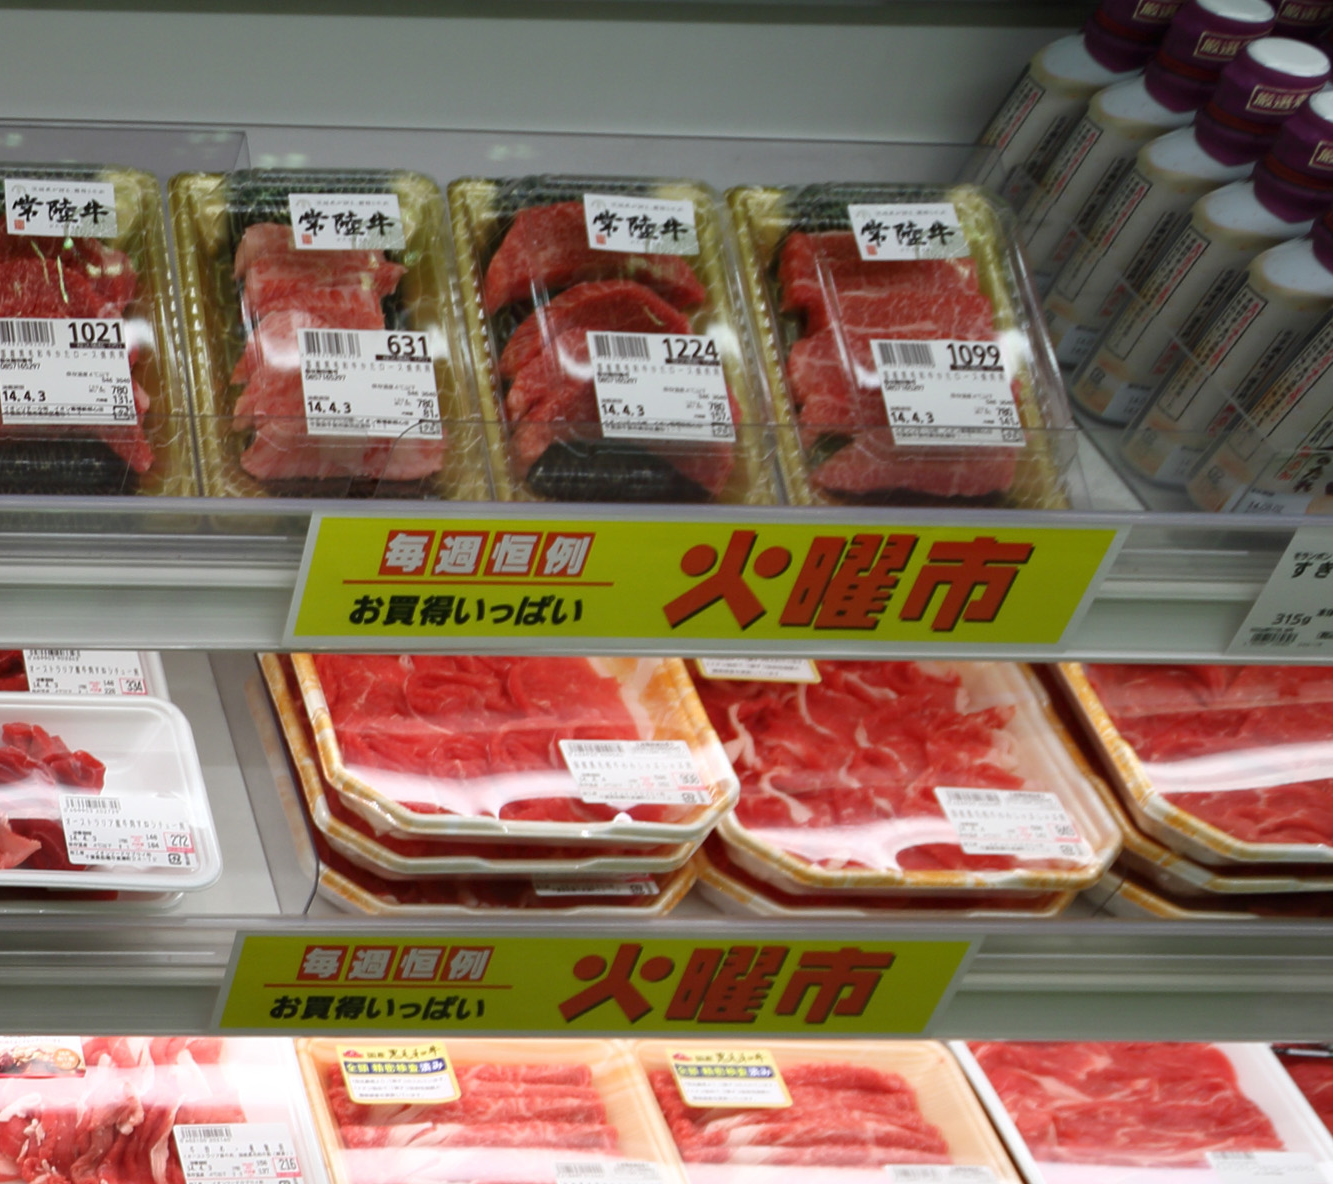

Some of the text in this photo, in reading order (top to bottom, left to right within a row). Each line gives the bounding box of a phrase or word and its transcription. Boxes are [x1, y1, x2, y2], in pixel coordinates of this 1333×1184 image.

[12, 199, 109, 225] 常陸牛
[298, 209, 394, 237] 常陸牛
[593, 211, 688, 241] 常陸牛
[861, 219, 954, 247] 常陸牛
[68, 322, 123, 343] 1021
[387, 335, 429, 356] 631
[662, 338, 719, 360] 1224
[947, 344, 1001, 368] 1099
[383, 532, 590, 576] 毎週恒例
[662, 530, 1033, 632] 火曜市
[349, 595, 583, 627] お買得いっぱい
[303, 947, 492, 980] 毎週恒例
[558, 943, 894, 1025] 火曜市
[270, 994, 486, 1021] お買得いっぱい
